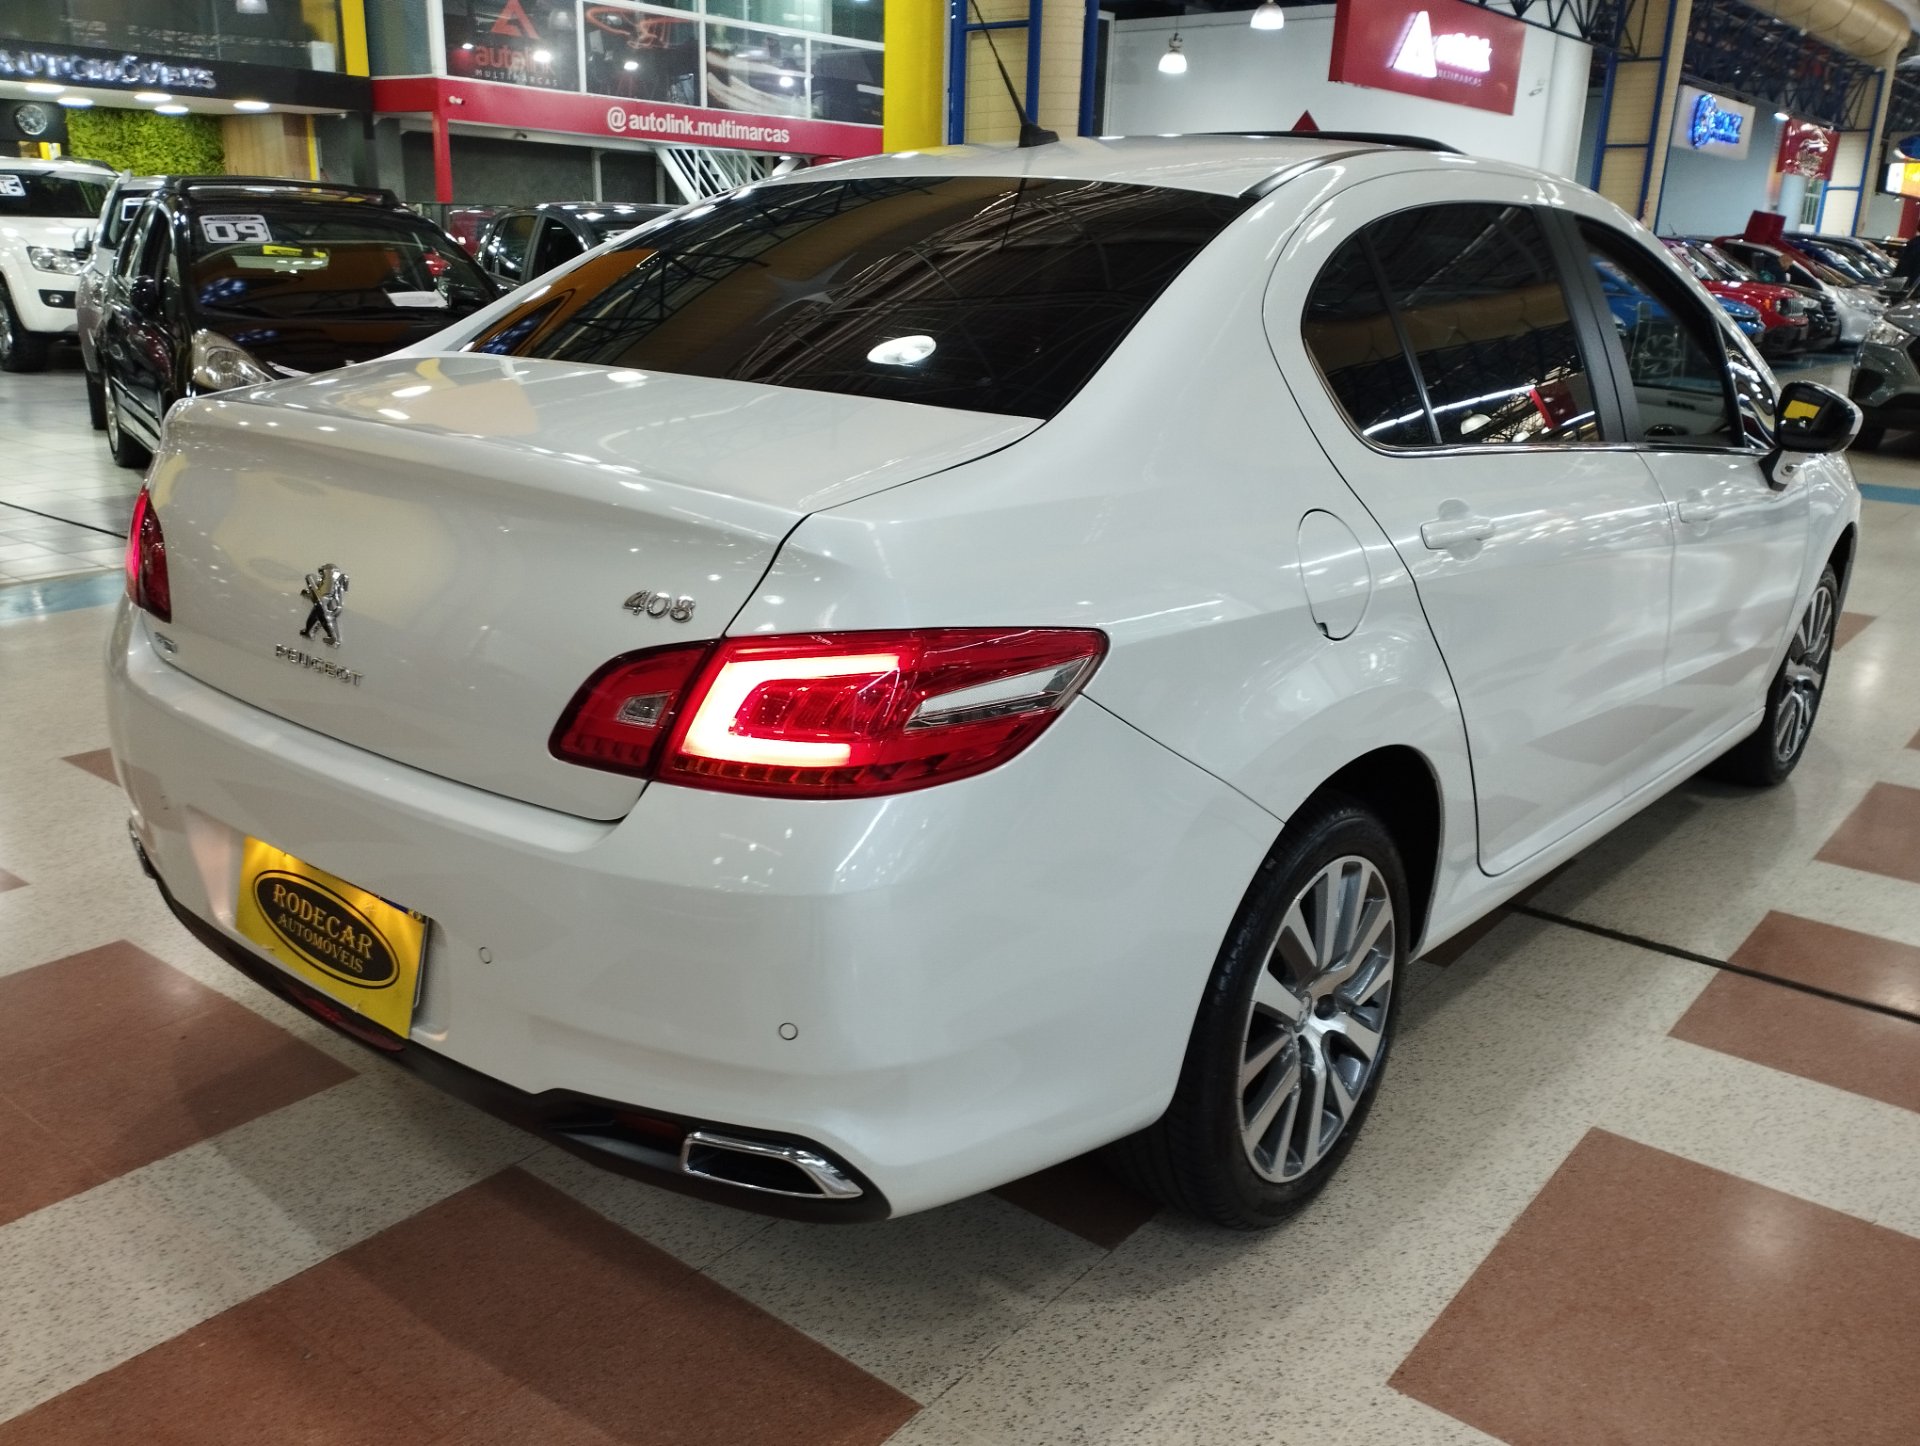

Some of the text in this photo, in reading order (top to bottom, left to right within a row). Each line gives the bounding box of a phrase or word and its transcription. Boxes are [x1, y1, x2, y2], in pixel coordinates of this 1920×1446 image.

[206, 222, 268, 241] 09
[623, 590, 696, 624] 408
[275, 643, 363, 687] PEUGEOT
[272, 883, 373, 960] RODECAR
